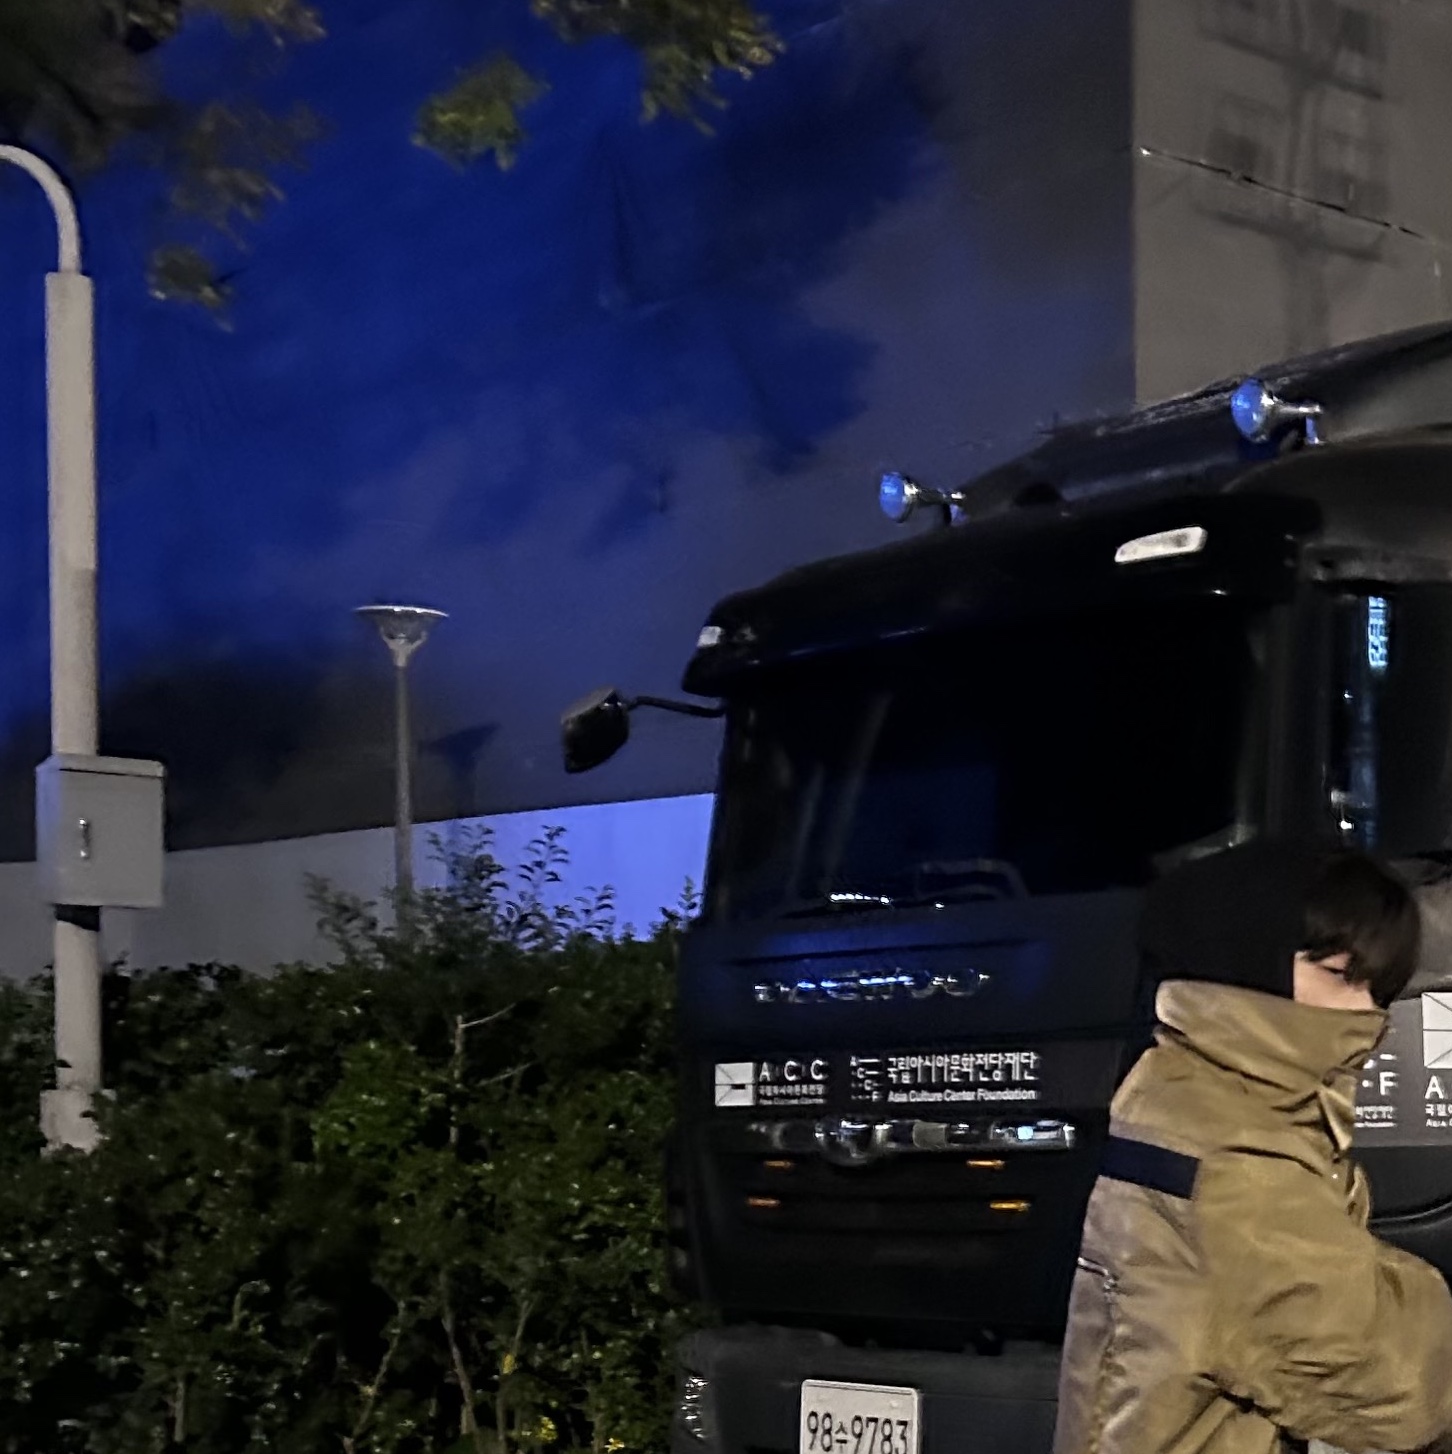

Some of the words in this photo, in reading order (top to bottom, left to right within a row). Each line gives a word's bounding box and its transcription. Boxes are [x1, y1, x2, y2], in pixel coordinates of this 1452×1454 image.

[887, 1052, 1038, 1084] 국립아시아문화전당재단
[887, 1088, 908, 1103] Asia
[908, 1089, 943, 1103] Culture
[943, 1088, 976, 1102] Center
[977, 1086, 1037, 1101] Foundation
